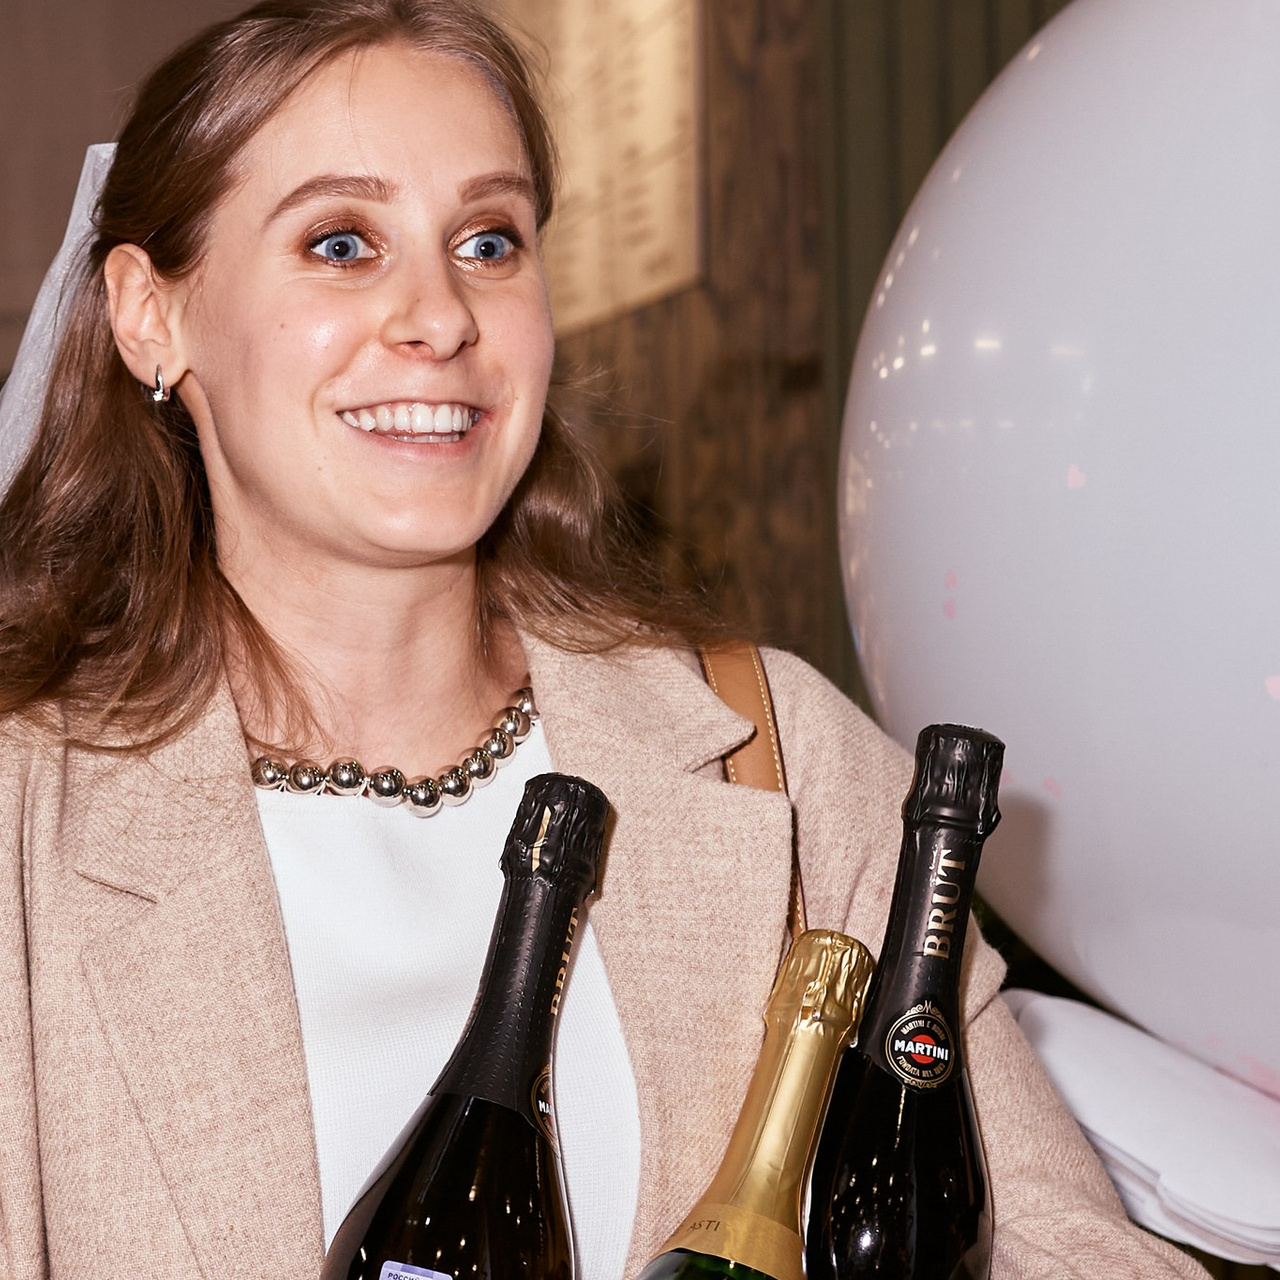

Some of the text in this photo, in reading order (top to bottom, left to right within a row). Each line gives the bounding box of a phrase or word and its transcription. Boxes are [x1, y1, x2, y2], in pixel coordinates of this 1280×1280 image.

[923, 849, 966, 959] BRUT
[894, 1039, 949, 1061] MARTINI
[686, 1220, 721, 1232] ASTI
